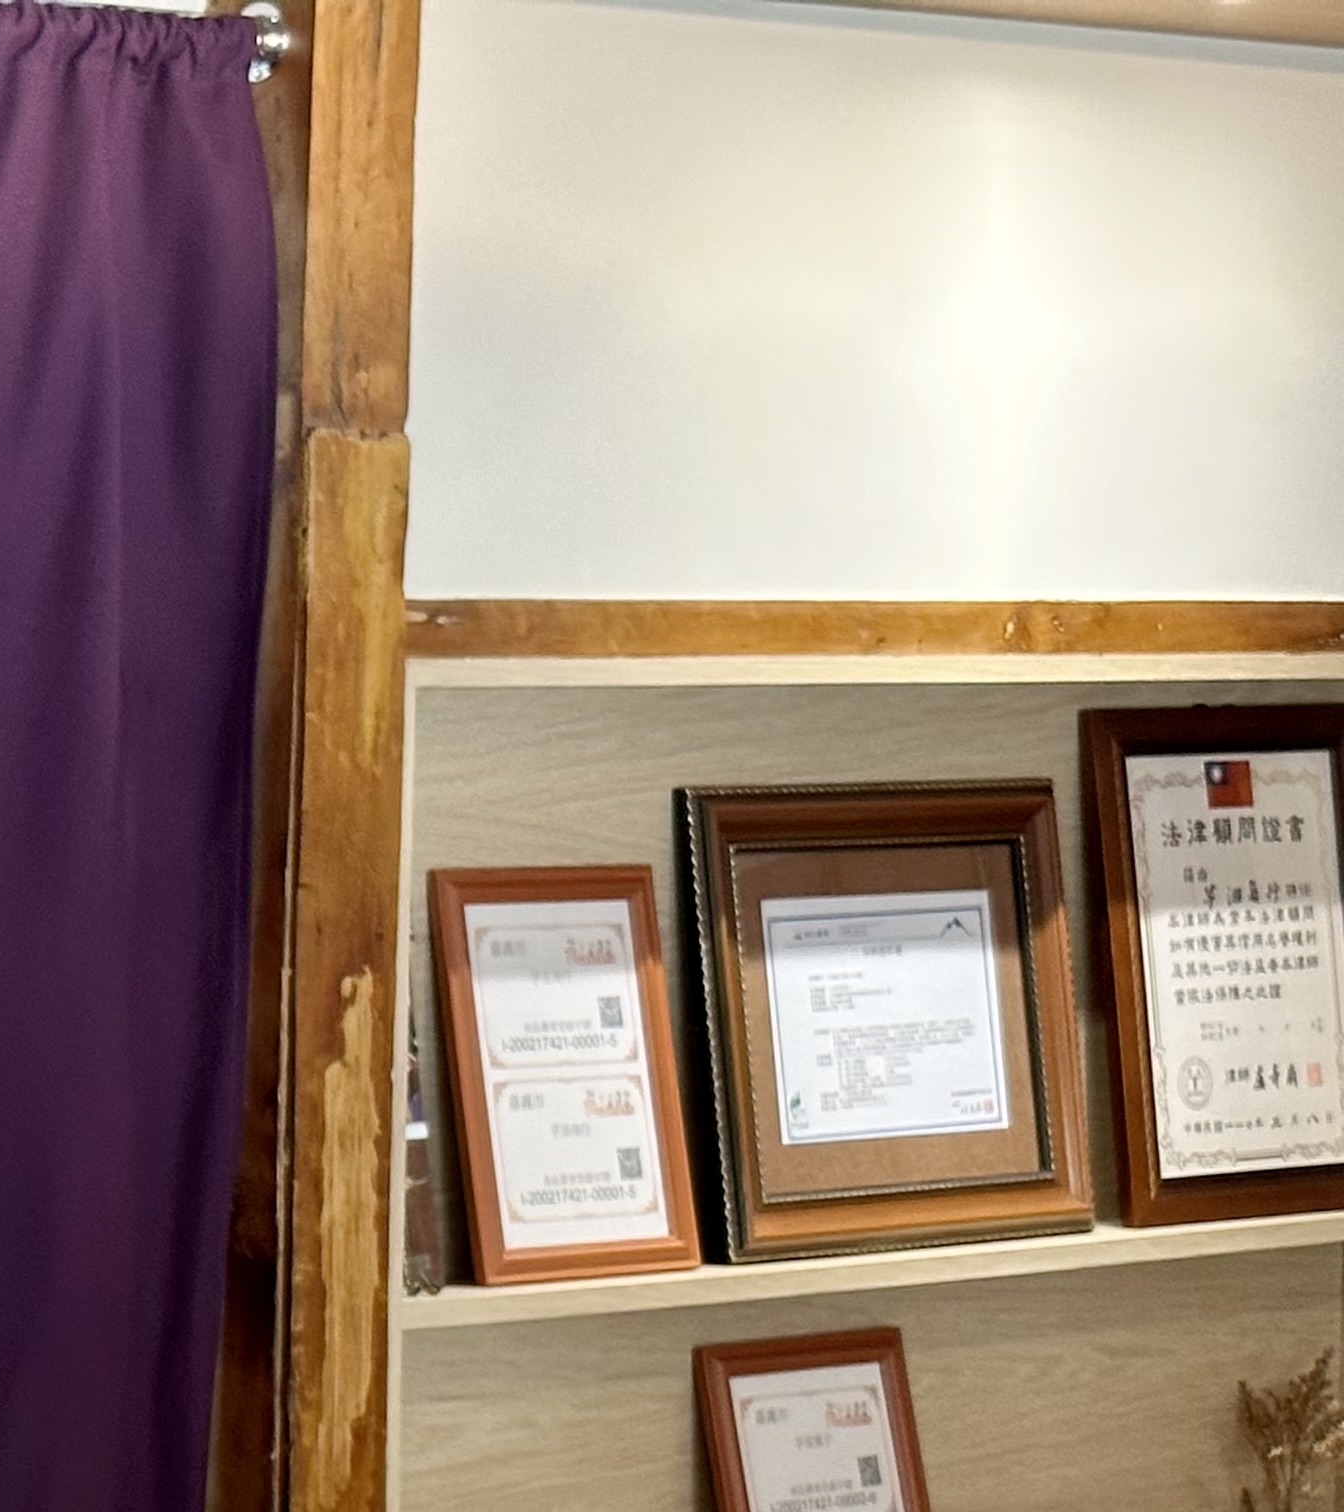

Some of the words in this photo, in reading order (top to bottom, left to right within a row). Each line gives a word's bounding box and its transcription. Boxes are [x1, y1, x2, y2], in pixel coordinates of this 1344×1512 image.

[1161, 815, 1305, 847] 法律顧問證書
